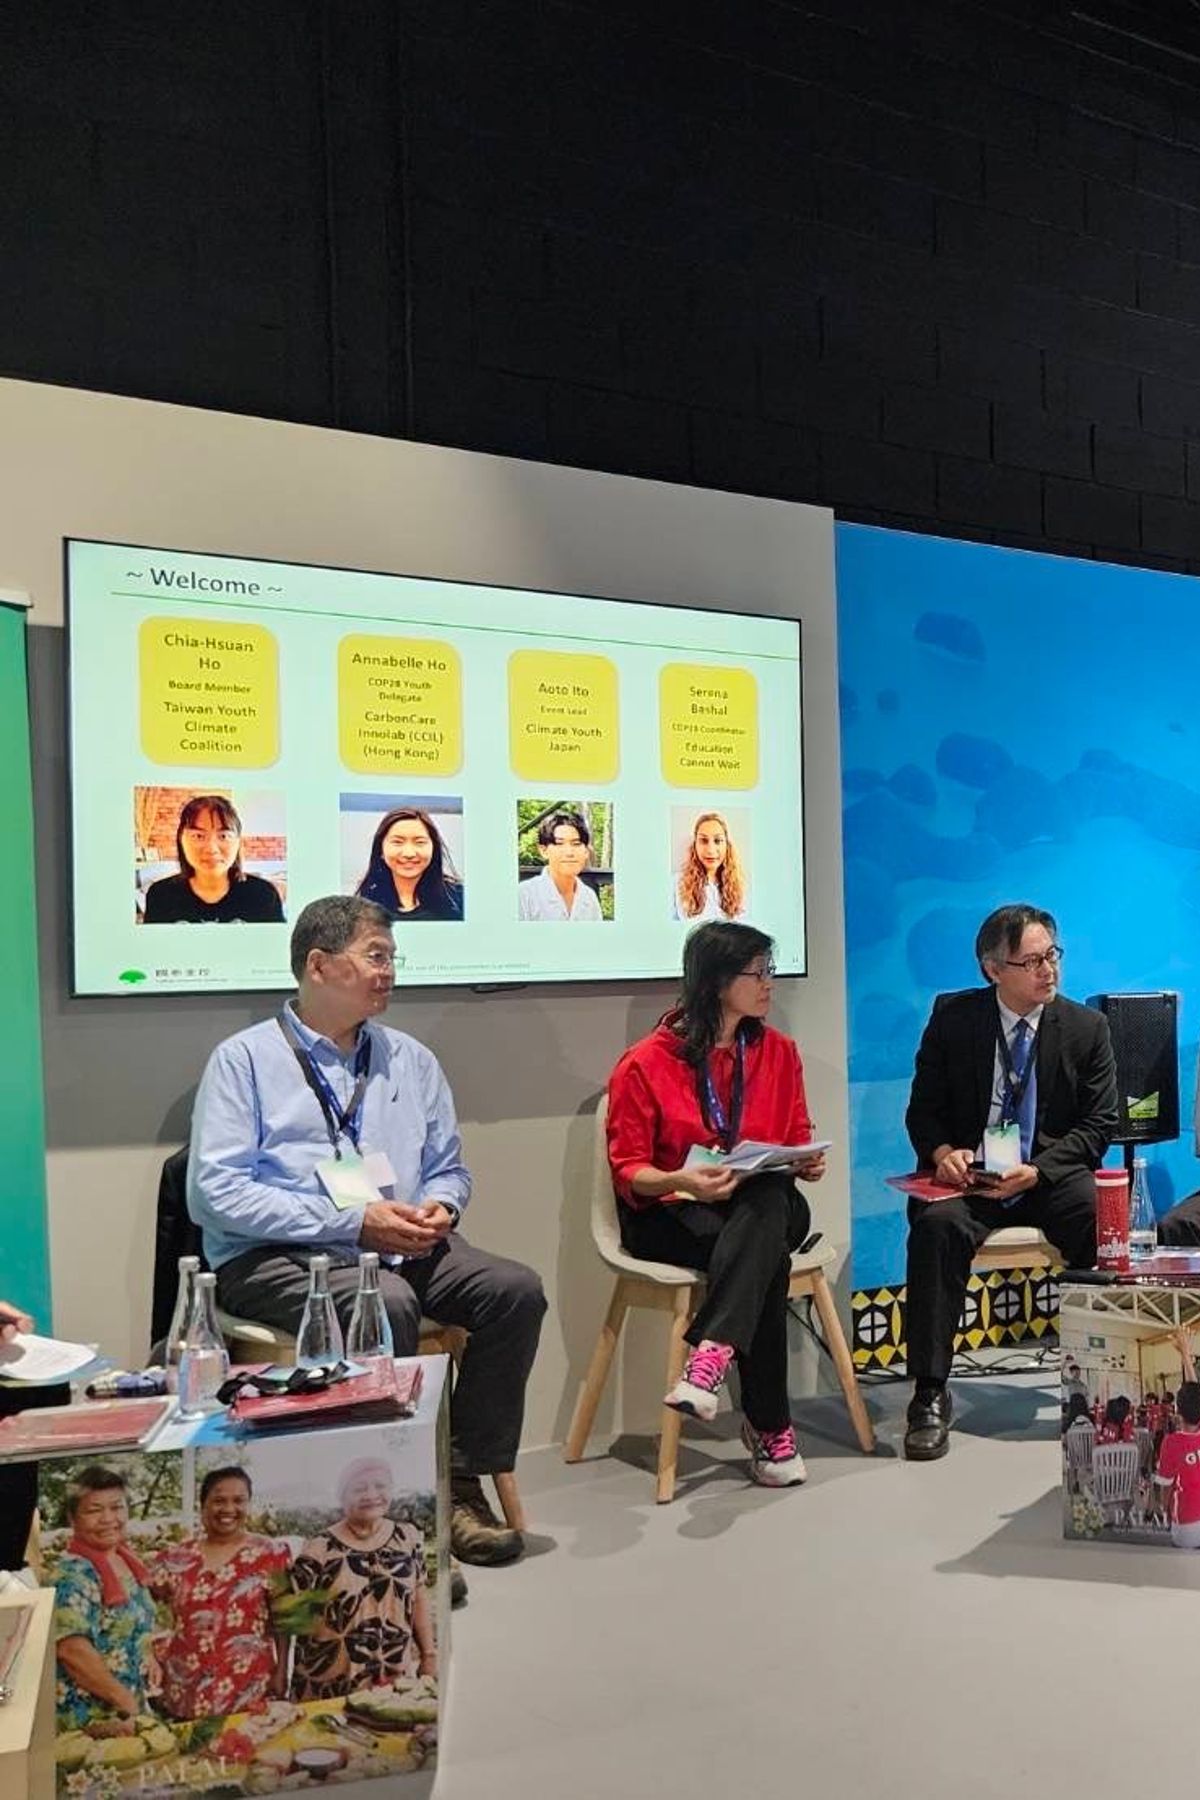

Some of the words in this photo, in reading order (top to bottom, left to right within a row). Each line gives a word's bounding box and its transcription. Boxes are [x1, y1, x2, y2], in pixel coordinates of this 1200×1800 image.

[150, 568, 261, 596] Welcome
[164, 633, 254, 652] Chia-Hsuan
[199, 657, 221, 670] Ho
[352, 653, 424, 669] Annabelle
[428, 659, 447, 671] Ho
[168, 680, 202, 690] Board
[204, 682, 251, 693] Member
[368, 677, 401, 688] COP28
[404, 680, 433, 689] Youth
[573, 686, 590, 697] Ito
[689, 686, 729, 699] Serena
[163, 701, 214, 715] Taiwan
[217, 705, 256, 717] Youth
[365, 710, 437, 725] CarbonCare
[184, 721, 237, 734] Climate
[526, 723, 568, 735] Climate
[571, 727, 602, 738] Youth
[180, 739, 243, 752] Coalition
[549, 741, 581, 752] Japan
[363, 744, 401, 759] (Hong
[404, 748, 440, 761] Kong)
[680, 757, 715, 768] Cannot
